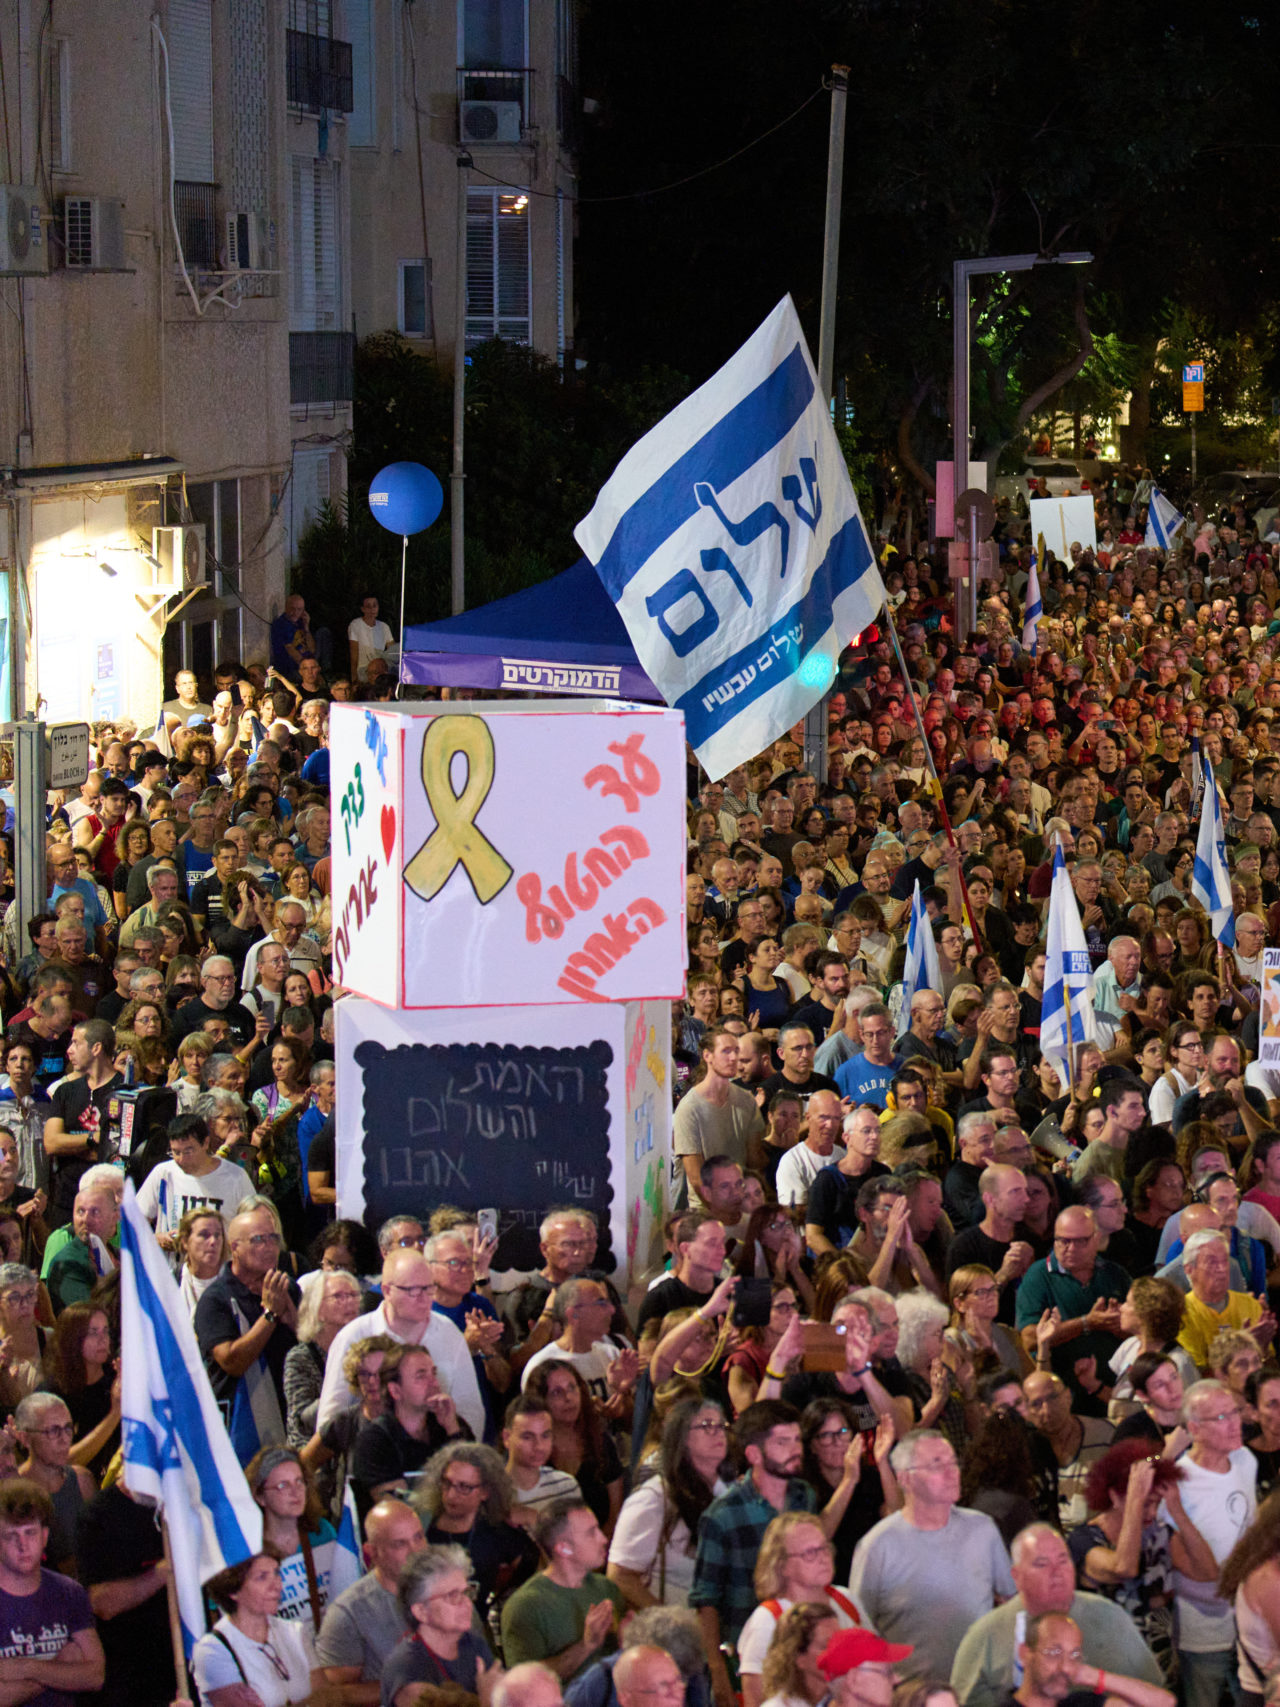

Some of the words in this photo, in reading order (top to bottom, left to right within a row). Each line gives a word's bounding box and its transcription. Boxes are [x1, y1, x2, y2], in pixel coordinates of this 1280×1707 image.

[645, 441, 822, 658] שלום
[757, 622, 804, 672] שלום
[503, 664, 620, 690] הדמוקרטים
[702, 664, 757, 713] עכשיו
[63, 766, 80, 780] BLOCH
[582, 731, 661, 813] עד
[516, 824, 650, 944] החטוף
[459, 1060, 584, 1103] האמת
[858, 1079, 877, 1094] OLD
[125, 1104, 135, 1139] CRIME
[407, 1076, 537, 1140] והשלום
[380, 1147, 471, 1190] אהבו
